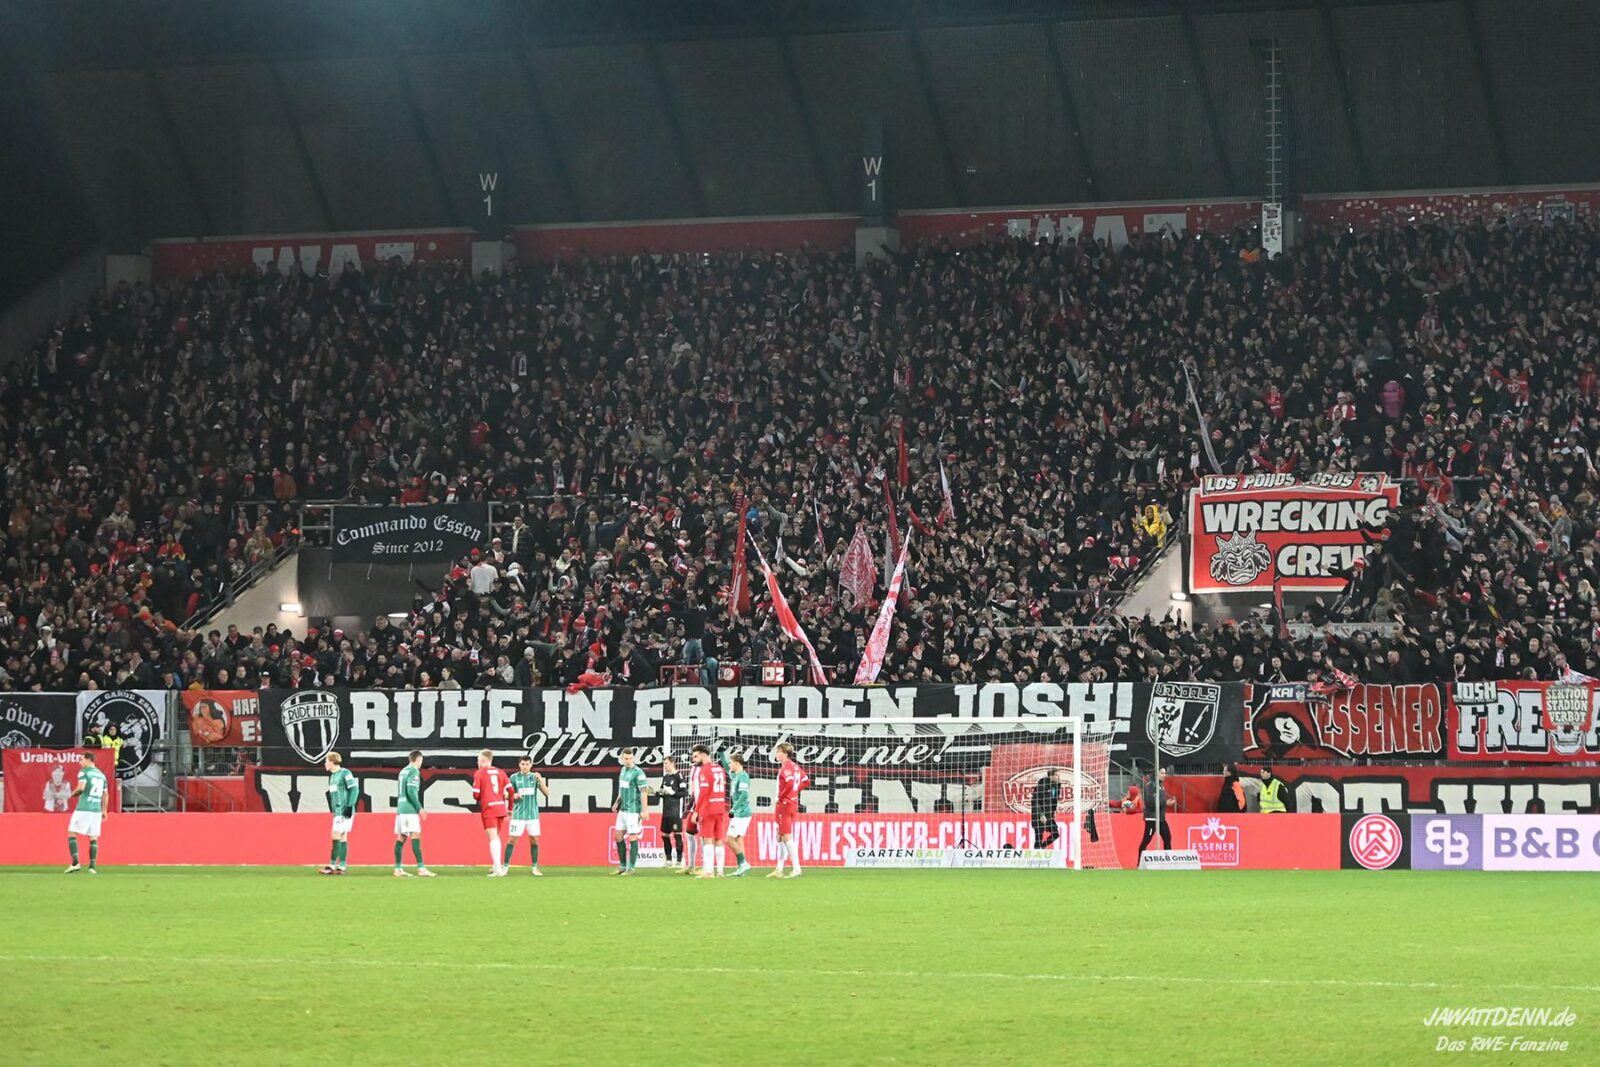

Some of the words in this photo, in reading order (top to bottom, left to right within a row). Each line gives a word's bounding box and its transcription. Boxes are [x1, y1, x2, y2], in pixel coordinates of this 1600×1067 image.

[863, 156, 882, 176] W
[480, 172, 498, 191] W
[867, 179, 876, 201] 1
[483, 194, 491, 217] 1
[1206, 475, 1238, 492] LOS
[1203, 499, 1390, 532] WRECKING
[336, 515, 428, 545] Commando
[433, 515, 482, 541] Essen
[372, 541, 409, 555] Since
[412, 539, 444, 552] 2012
[1271, 688, 1294, 698] KAI
[1453, 681, 1497, 702] JOSH
[1546, 688, 1588, 700] SEKTION
[288, 706, 311, 721] RUDE
[313, 704, 334, 716] FANS
[350, 689, 523, 741] RUHE
[542, 689, 614, 740] IN
[632, 686, 917, 738] FRIEDEN
[937, 682, 1134, 735] JOSH!
[1546, 699, 1588, 711] STADION
[0, 701, 54, 738] öwen
[1549, 710, 1587, 722] VERBOT
[859, 735, 955, 765] nie!
[1192, 842, 1235, 851] ESSENER
[1494, 827, 1580, 859] B&B
[1200, 852, 1235, 861] HANCEN
